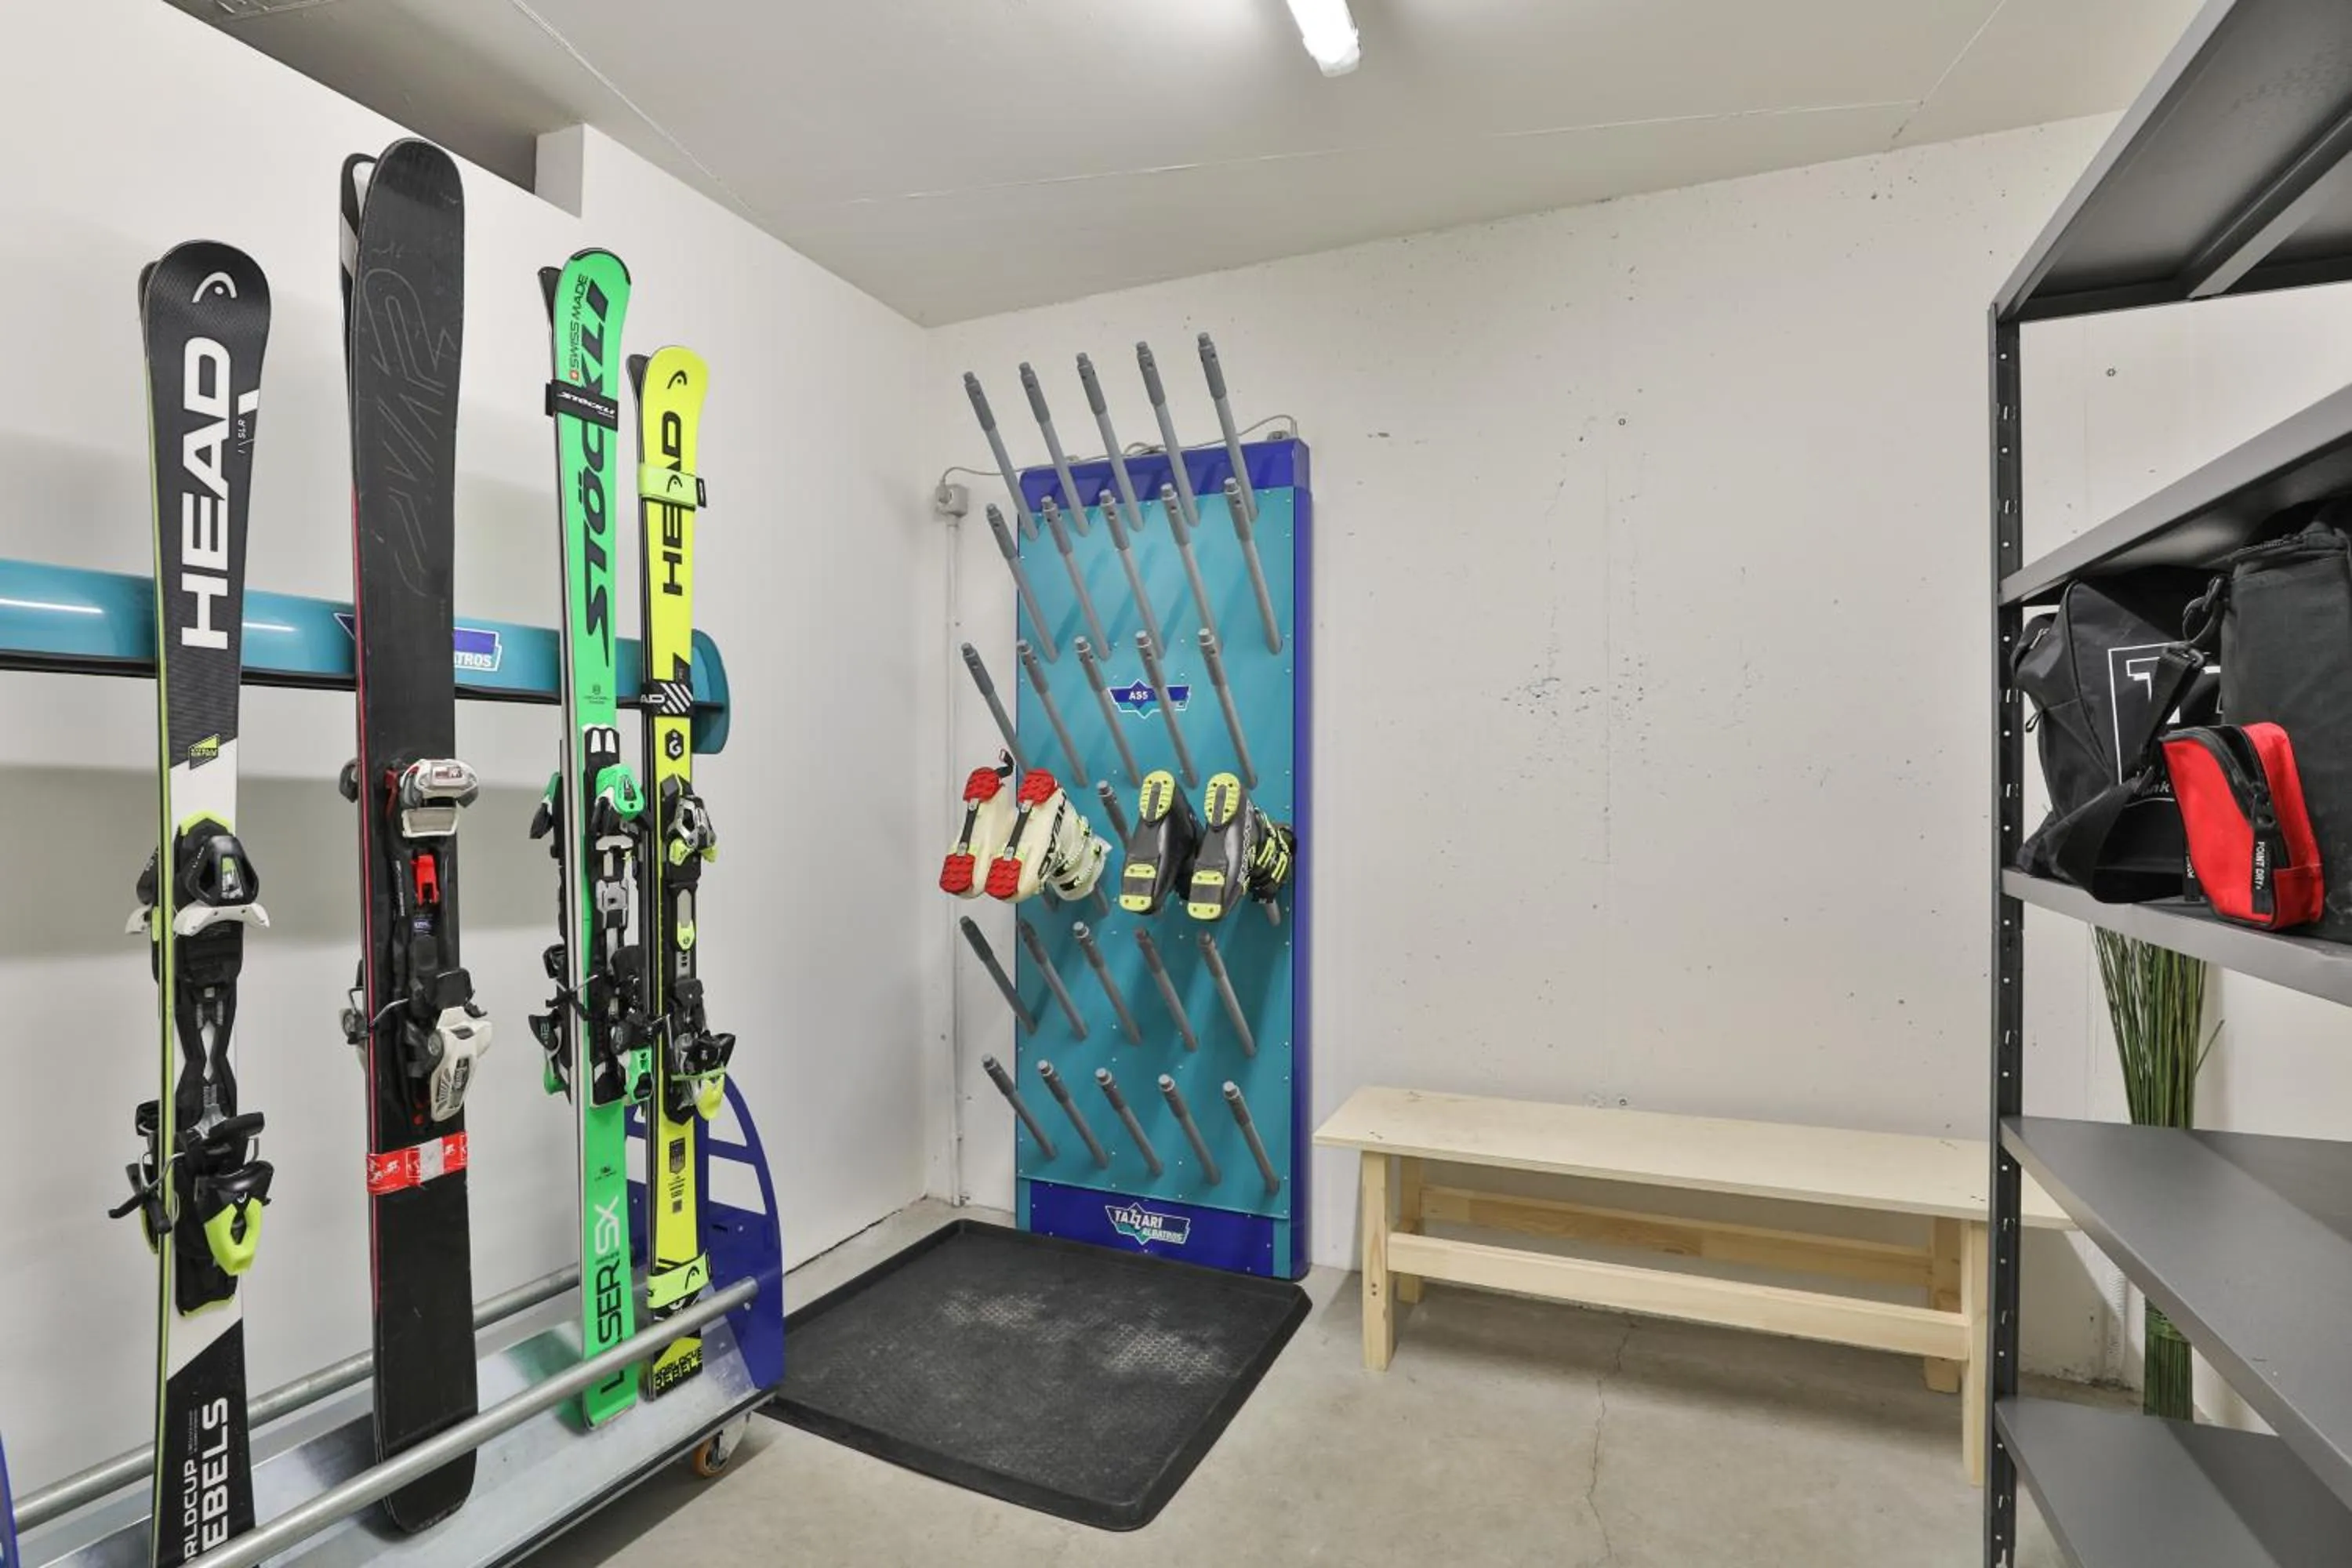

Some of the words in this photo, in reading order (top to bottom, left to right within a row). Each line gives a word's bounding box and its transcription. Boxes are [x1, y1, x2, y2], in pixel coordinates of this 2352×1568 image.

[572, 274, 589, 321] MADE
[570, 321, 580, 369] SWISS
[181, 336, 231, 650] HEAD
[662, 411, 683, 596] HED
[454, 652, 492, 667] TROS
[2254, 868, 2265, 886] DRY
[2256, 840, 2266, 867] POINT
[593, 1195, 620, 1254] SX
[1113, 1209, 1163, 1229] TAZZARI
[594, 1258, 625, 1394] LSER
[201, 1397, 228, 1552] EBELS
[183, 1458, 198, 1560] RLDCUP
